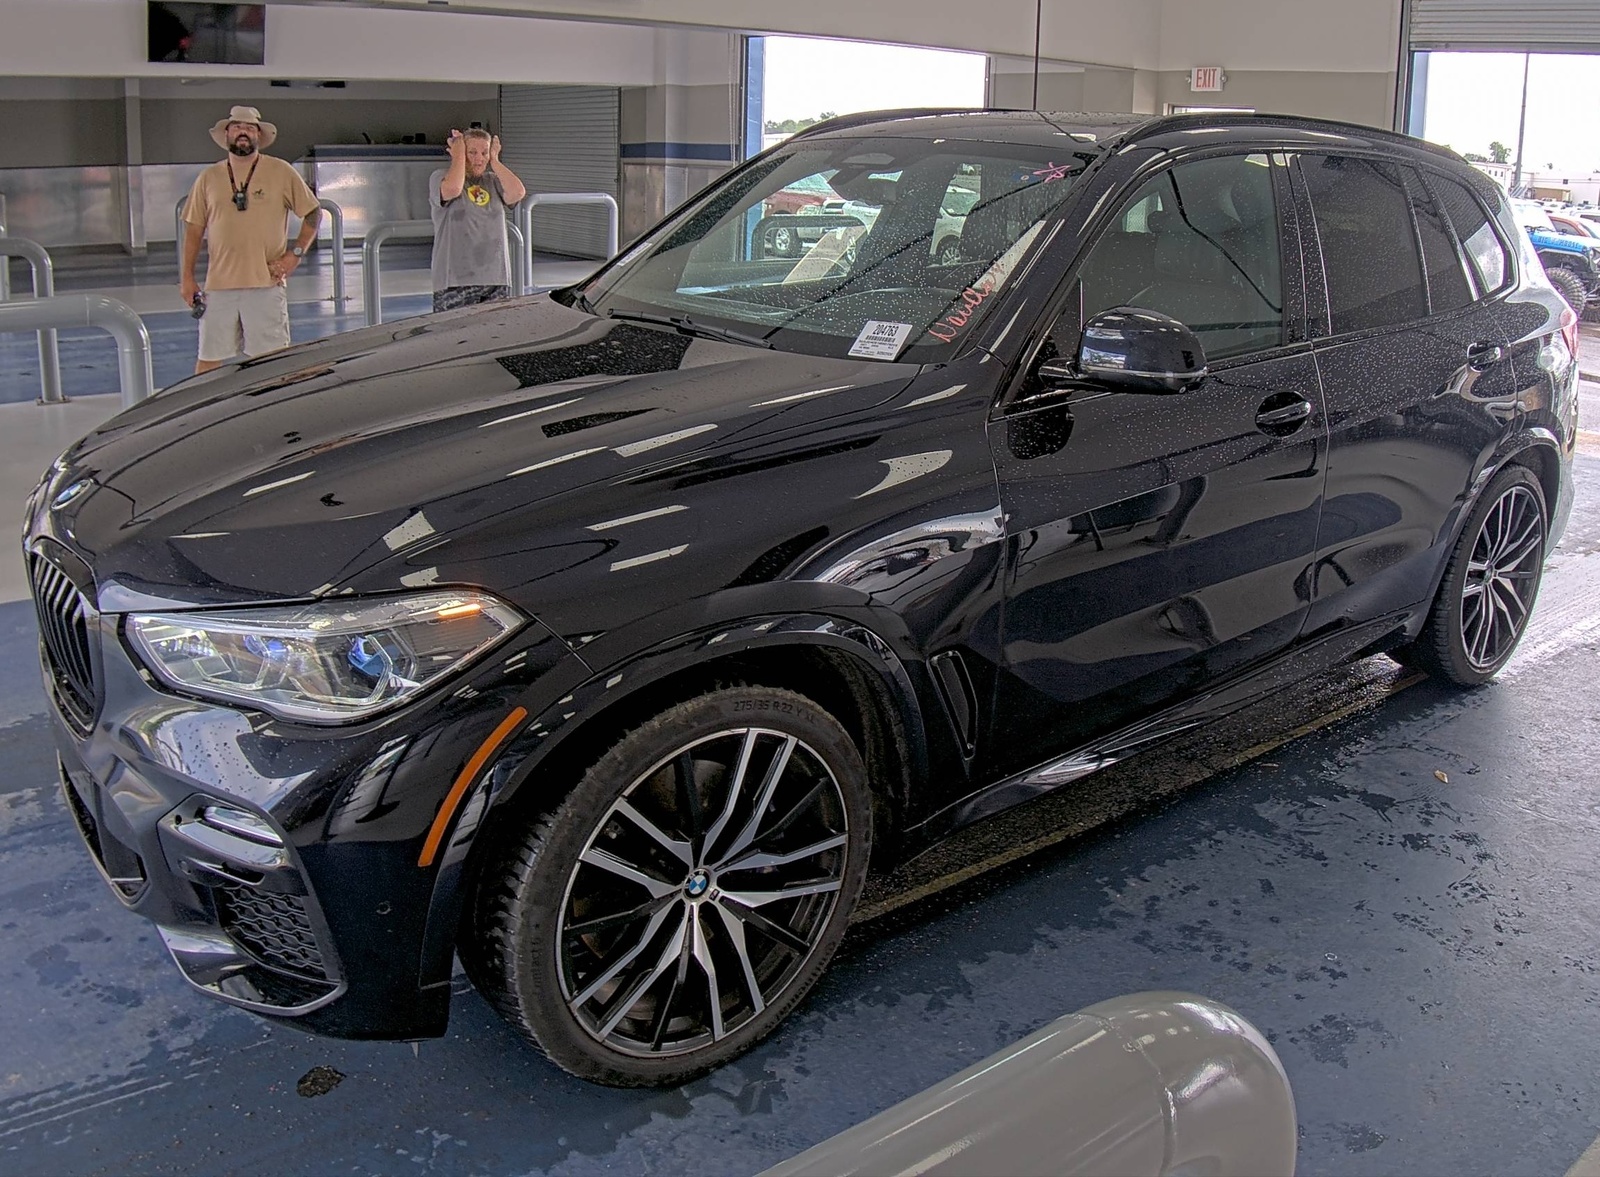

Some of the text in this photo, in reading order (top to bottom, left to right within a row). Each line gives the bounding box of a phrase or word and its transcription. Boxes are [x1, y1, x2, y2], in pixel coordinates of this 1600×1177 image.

[1196, 68, 1217, 88] EXIT
[872, 324, 899, 337] 204763
[733, 700, 769, 712] 275/35
